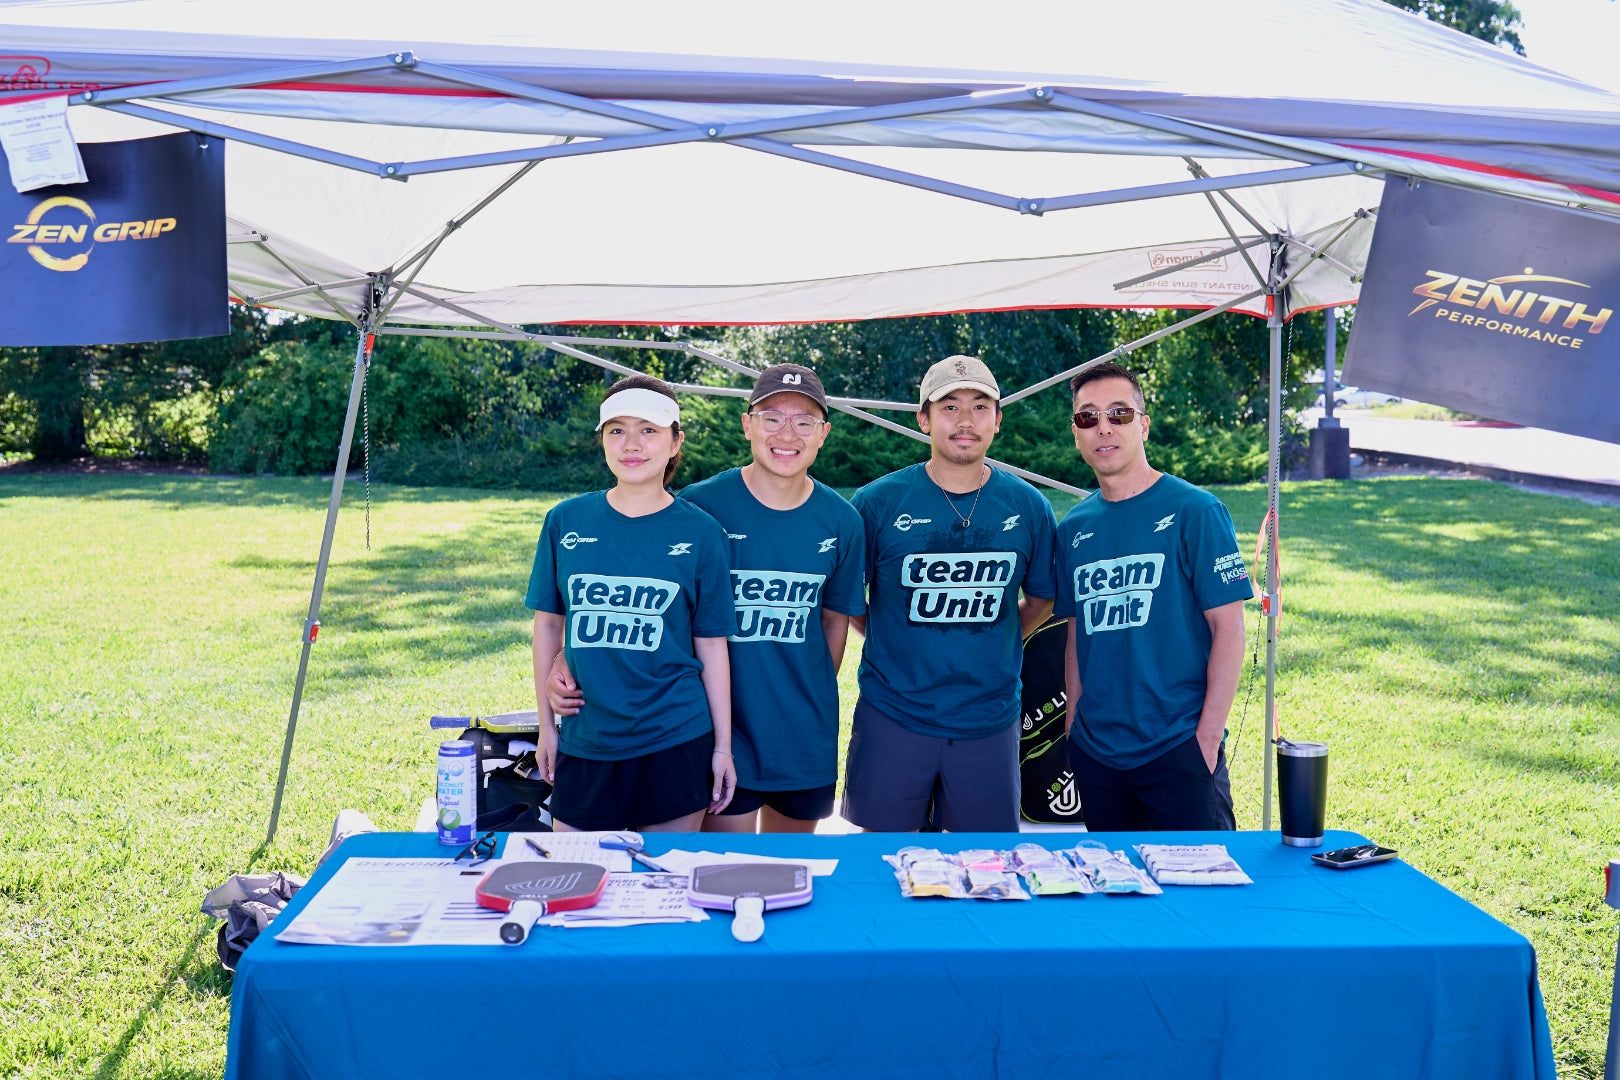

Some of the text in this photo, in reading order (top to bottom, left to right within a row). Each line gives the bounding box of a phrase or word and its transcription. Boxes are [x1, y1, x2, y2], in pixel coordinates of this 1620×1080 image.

[7, 217, 177, 243] ZEN GRIP
[1411, 269, 1613, 334] ZENITH
[1435, 308, 1584, 349] PERFORMANCE
[908, 557, 1011, 584] team
[1077, 561, 1156, 595] team
[571, 577, 669, 610] team
[730, 573, 820, 604] team
[917, 590, 997, 618] Unit
[735, 609, 804, 639] Unit
[1090, 594, 1145, 628] Unit
[577, 615, 657, 648] Unit
